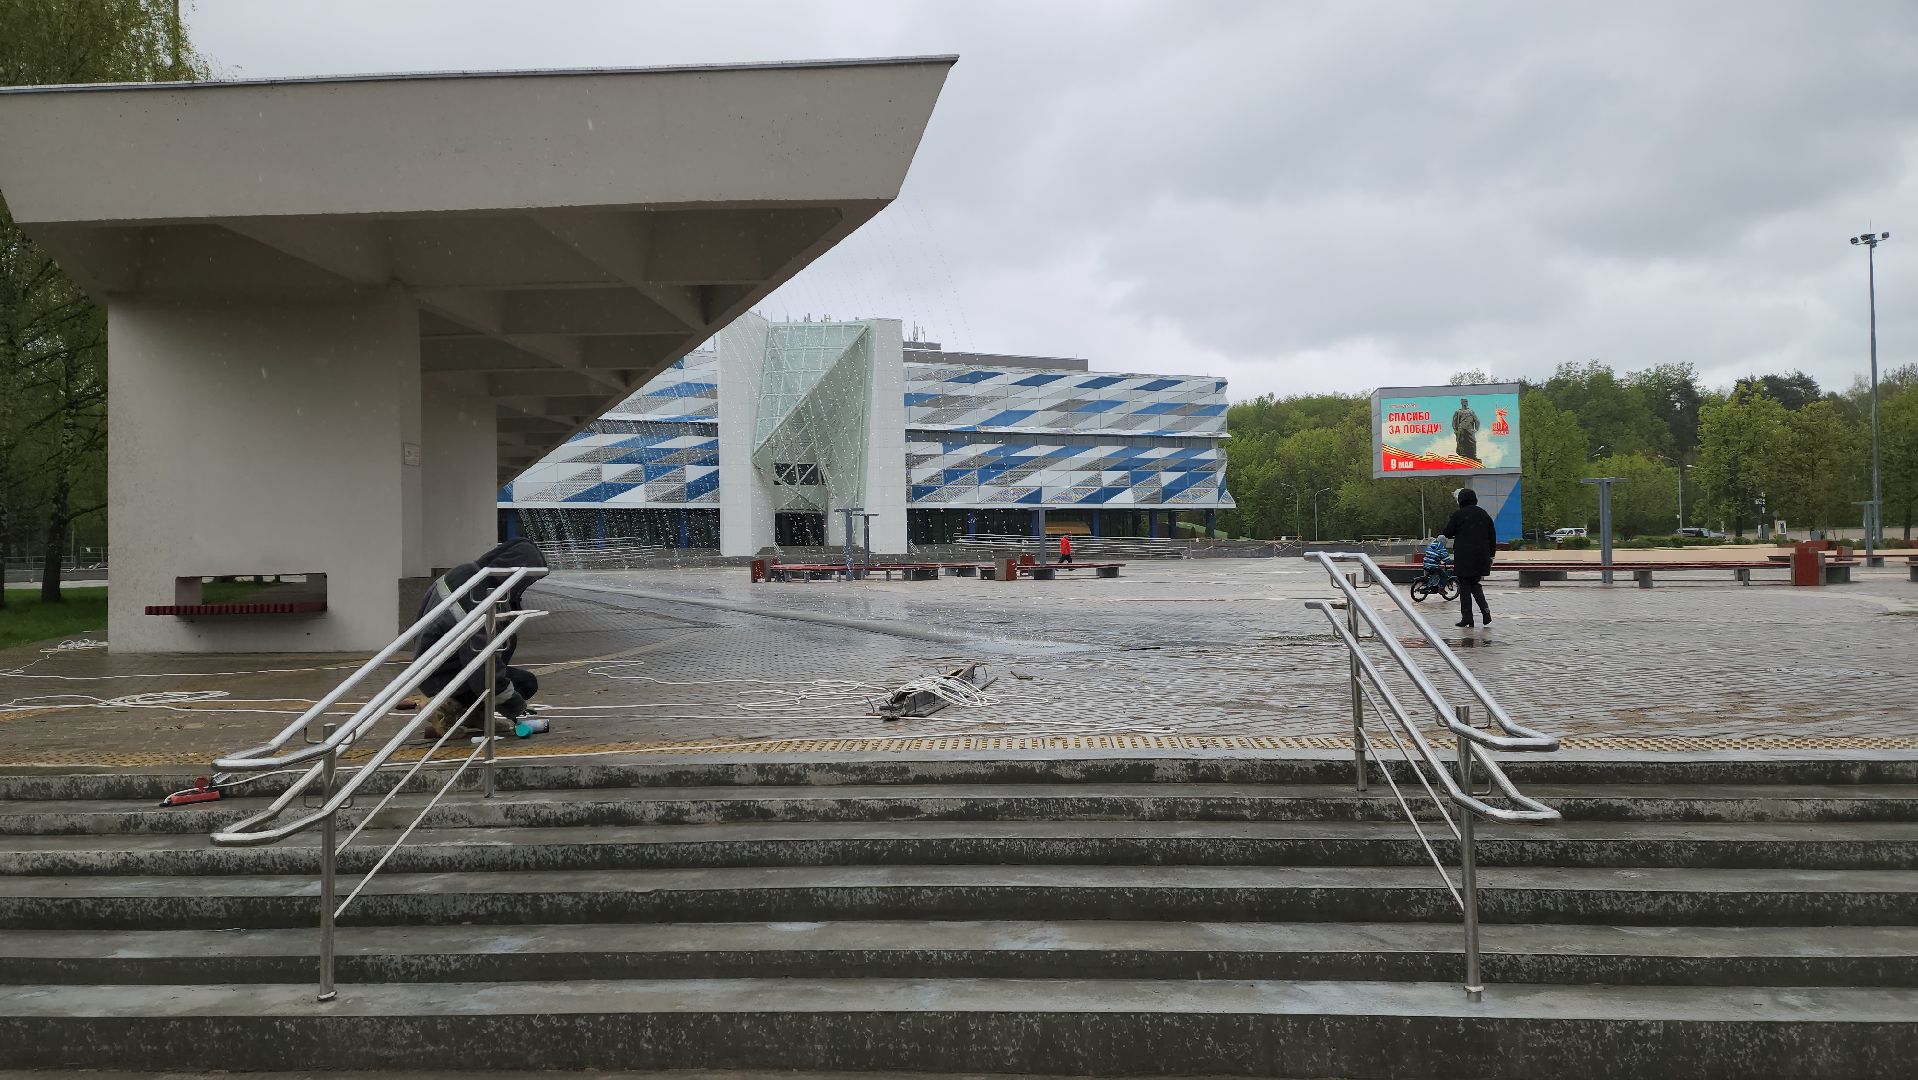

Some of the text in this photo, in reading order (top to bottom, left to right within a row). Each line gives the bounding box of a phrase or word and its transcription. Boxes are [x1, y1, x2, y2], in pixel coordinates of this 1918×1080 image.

[1388, 411, 1430, 422] СПАСИБО
[1388, 423, 1442, 435] ЗА ПОБЕДУ!
[1390, 458, 1397, 470] 9
